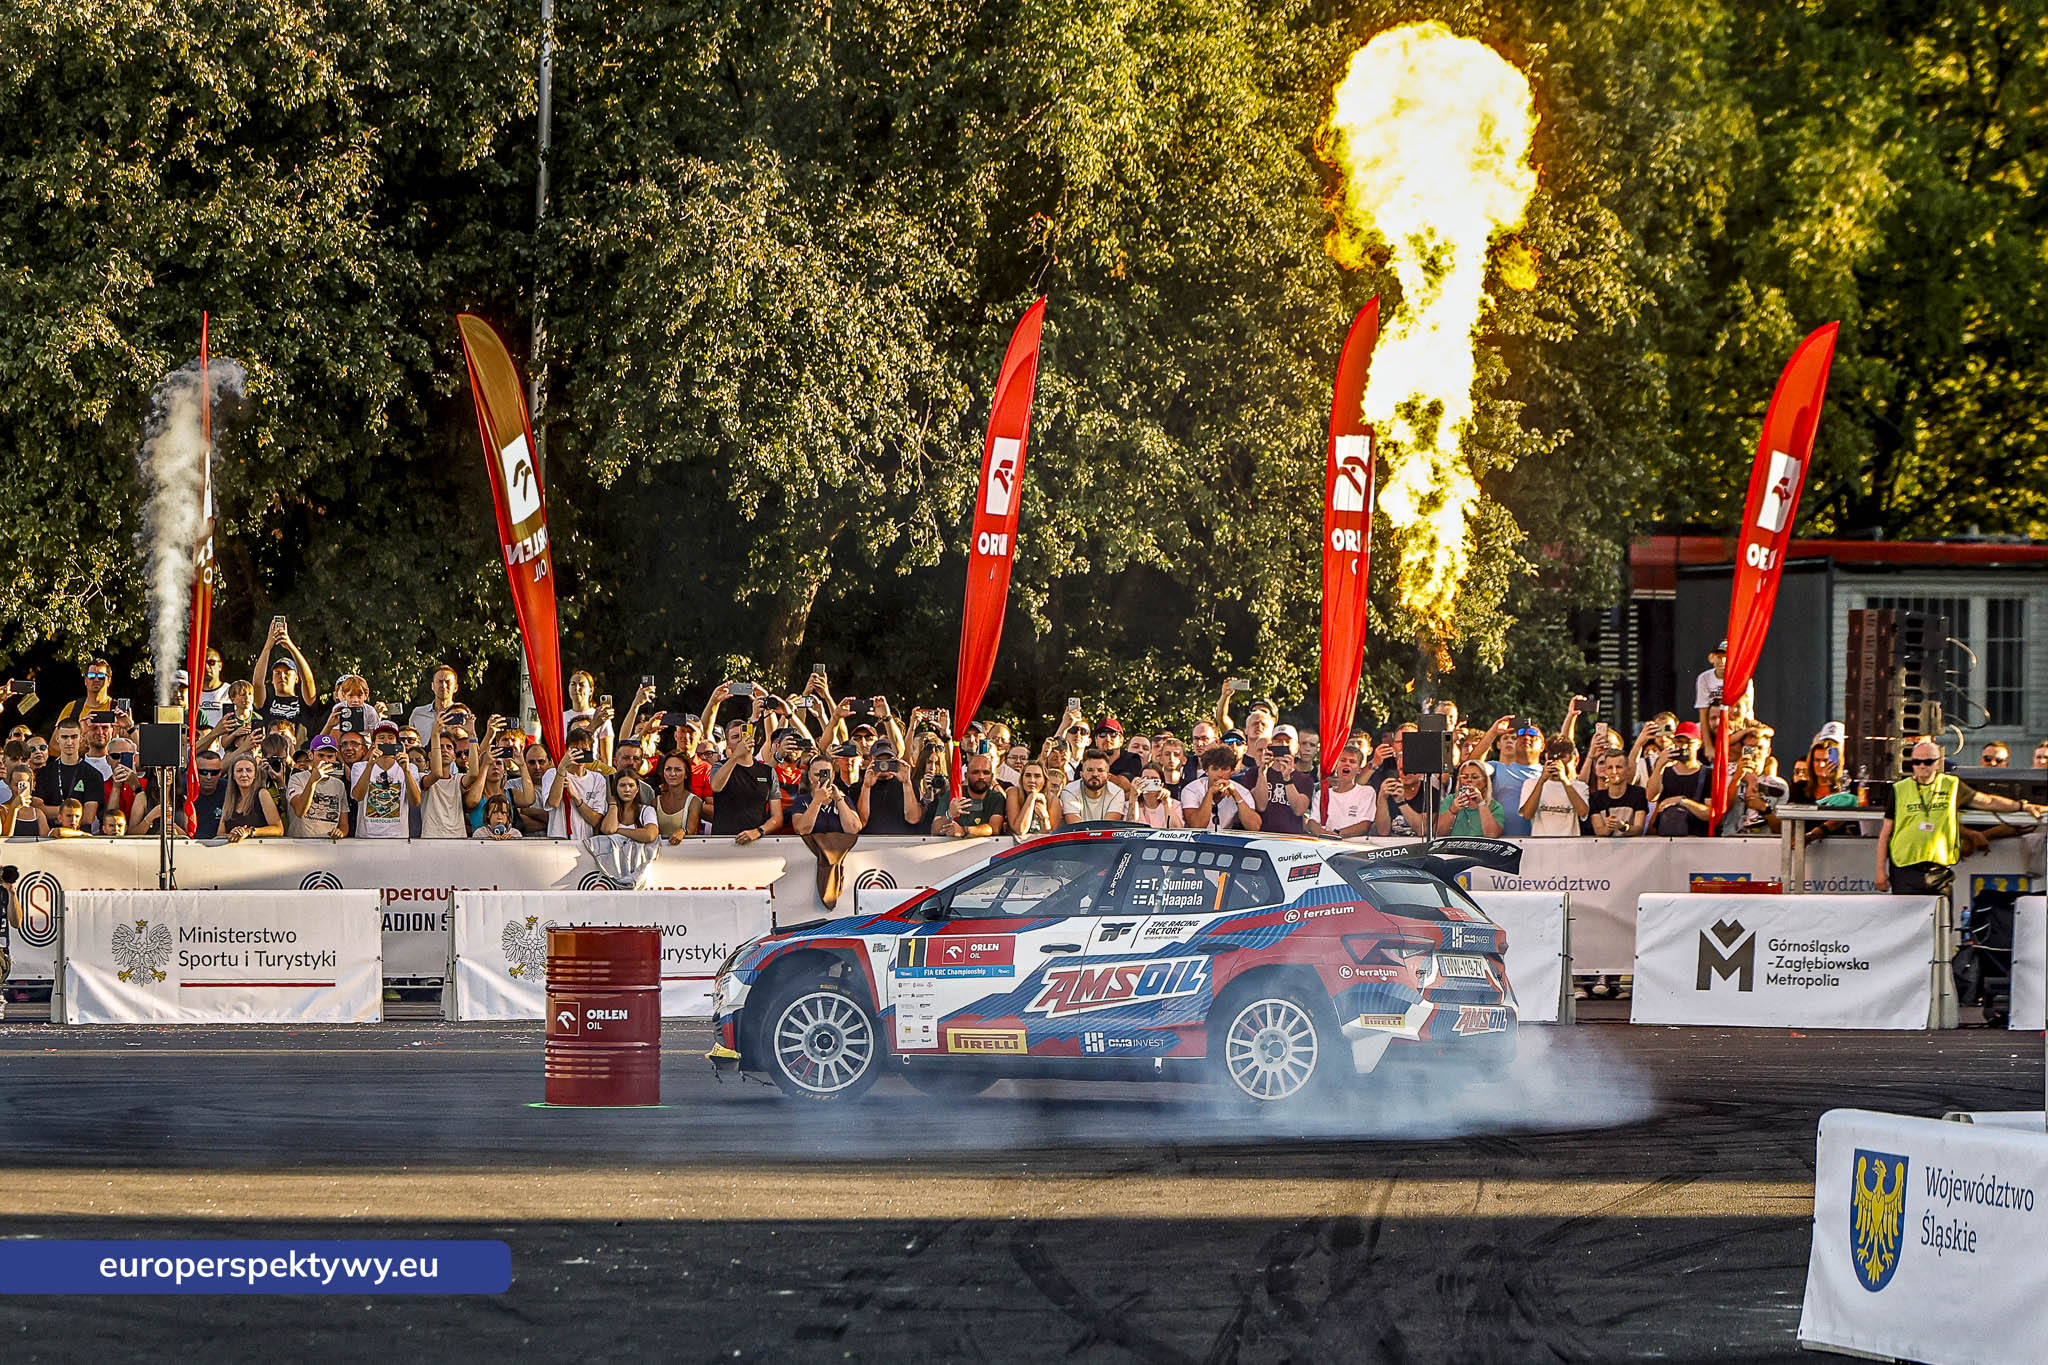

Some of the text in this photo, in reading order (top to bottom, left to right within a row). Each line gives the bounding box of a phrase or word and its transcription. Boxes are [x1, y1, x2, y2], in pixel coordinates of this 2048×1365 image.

[1290, 864, 1321, 877] ETS
[1151, 878, 1203, 891] T. Suninen
[1213, 872, 1227, 911] 1
[1147, 893, 1203, 908] A. Haapala
[1303, 906, 1355, 919] ferratum
[382, 912, 436, 932] ADION
[1169, 920, 1200, 928] RACING
[179, 926, 297, 944] Ministerstwo
[1144, 928, 1183, 936] FACTORY
[661, 943, 727, 962] urystyki
[908, 938, 916, 967] 1
[970, 943, 1000, 952] ORLEN
[1768, 938, 1850, 956] Górnośląsko
[178, 950, 337, 971] Sportu i Turystyki
[935, 968, 946, 976] ERC
[947, 967, 987, 977] Championship
[1355, 968, 1398, 978] ferratum
[1766, 972, 1840, 989] Metropolia
[1034, 959, 1204, 1014] AMSOIL
[586, 1009, 629, 1020] ORLEN
[1456, 1007, 1507, 1035] AMSOIL
[586, 1021, 603, 1030] OIL
[954, 1033, 1019, 1049] PIRELLI
[1925, 1166, 2034, 1212] Województwo
[1920, 1208, 1977, 1257] Śląskie
